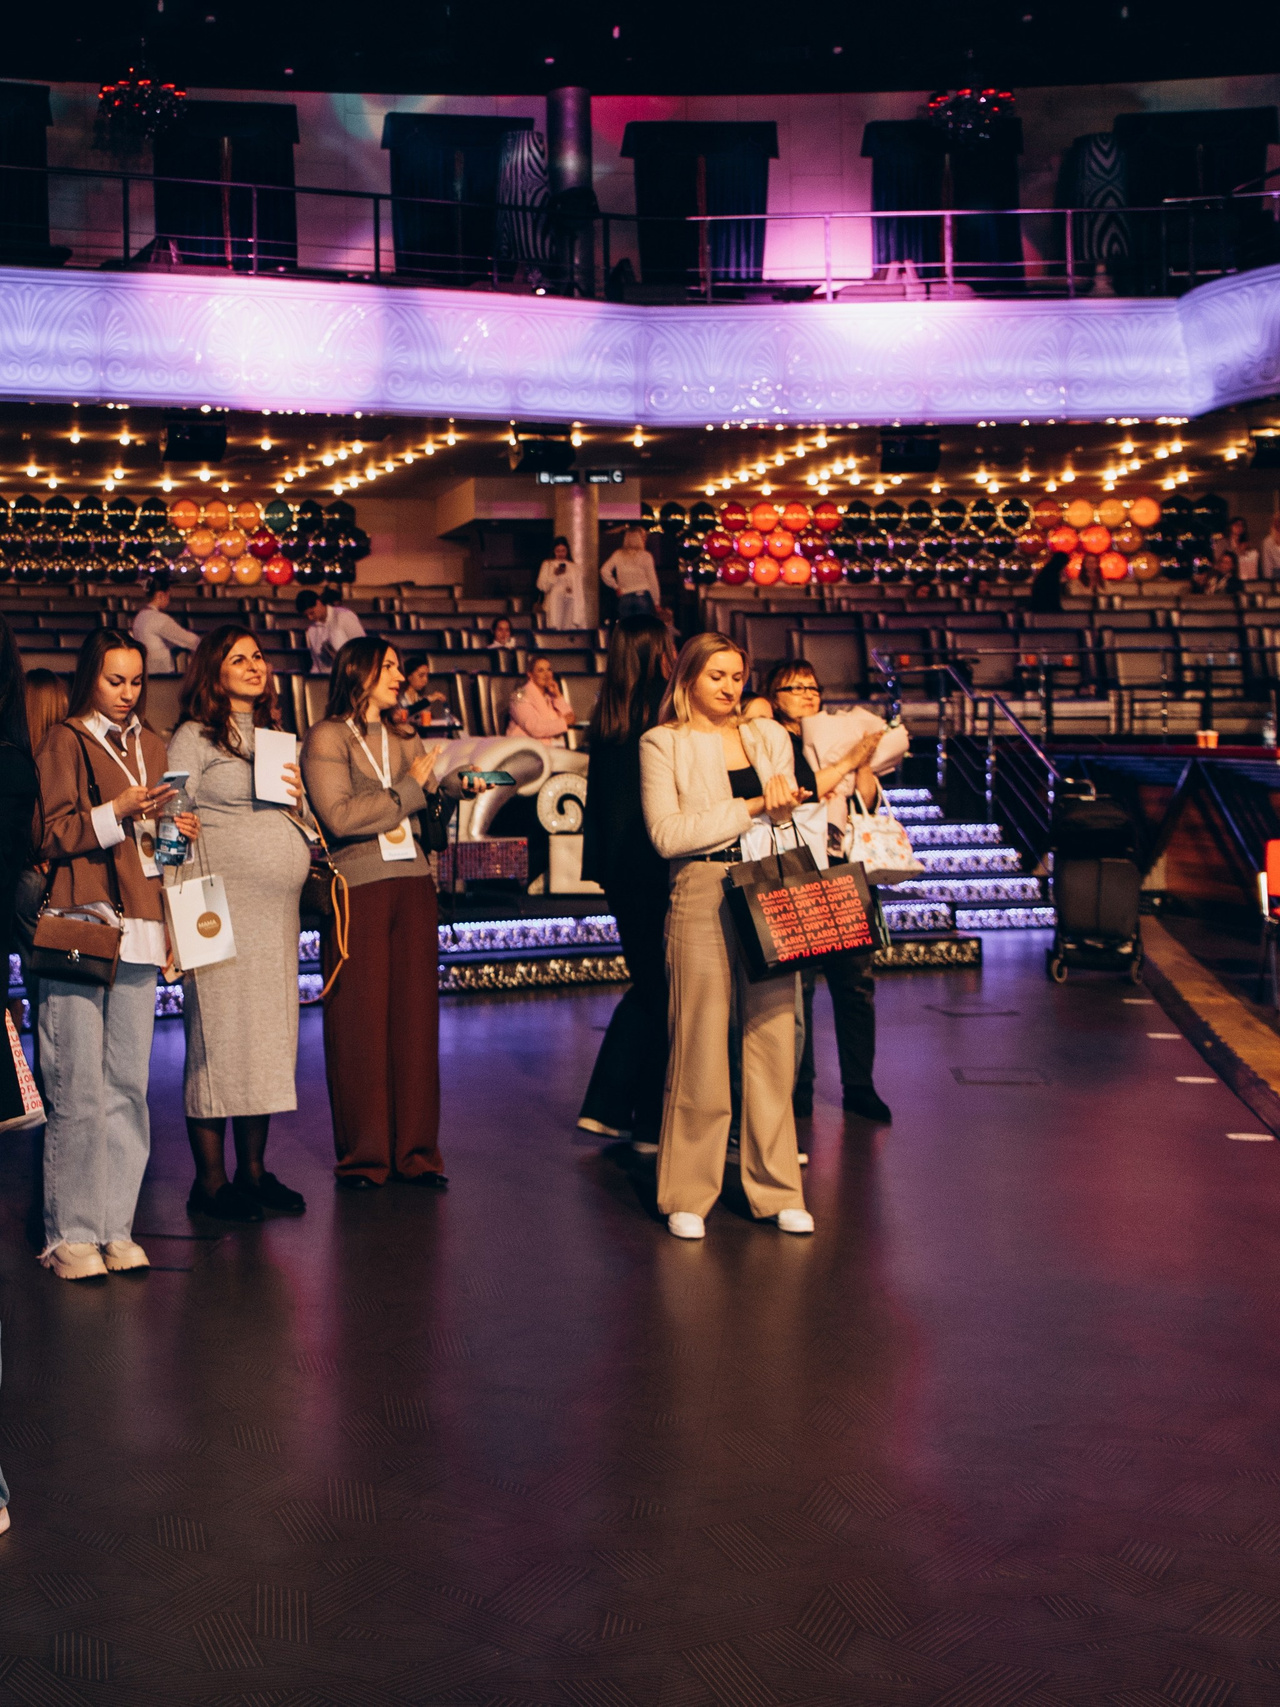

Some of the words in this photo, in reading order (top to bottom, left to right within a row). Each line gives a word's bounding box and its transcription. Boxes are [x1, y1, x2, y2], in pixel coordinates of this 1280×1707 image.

[757, 889, 788, 902] FLARIO
[789, 882, 821, 895] FLARIO
[821, 875, 853, 888] FLARIO
[766, 912, 797, 924] FLARIO
[797, 905, 829, 918] FLARIO
[830, 898, 861, 911] FLARIO
[773, 934, 805, 948] FLARIO
[806, 928, 837, 941] FLARIO
[838, 921, 868, 934] FLARIO
